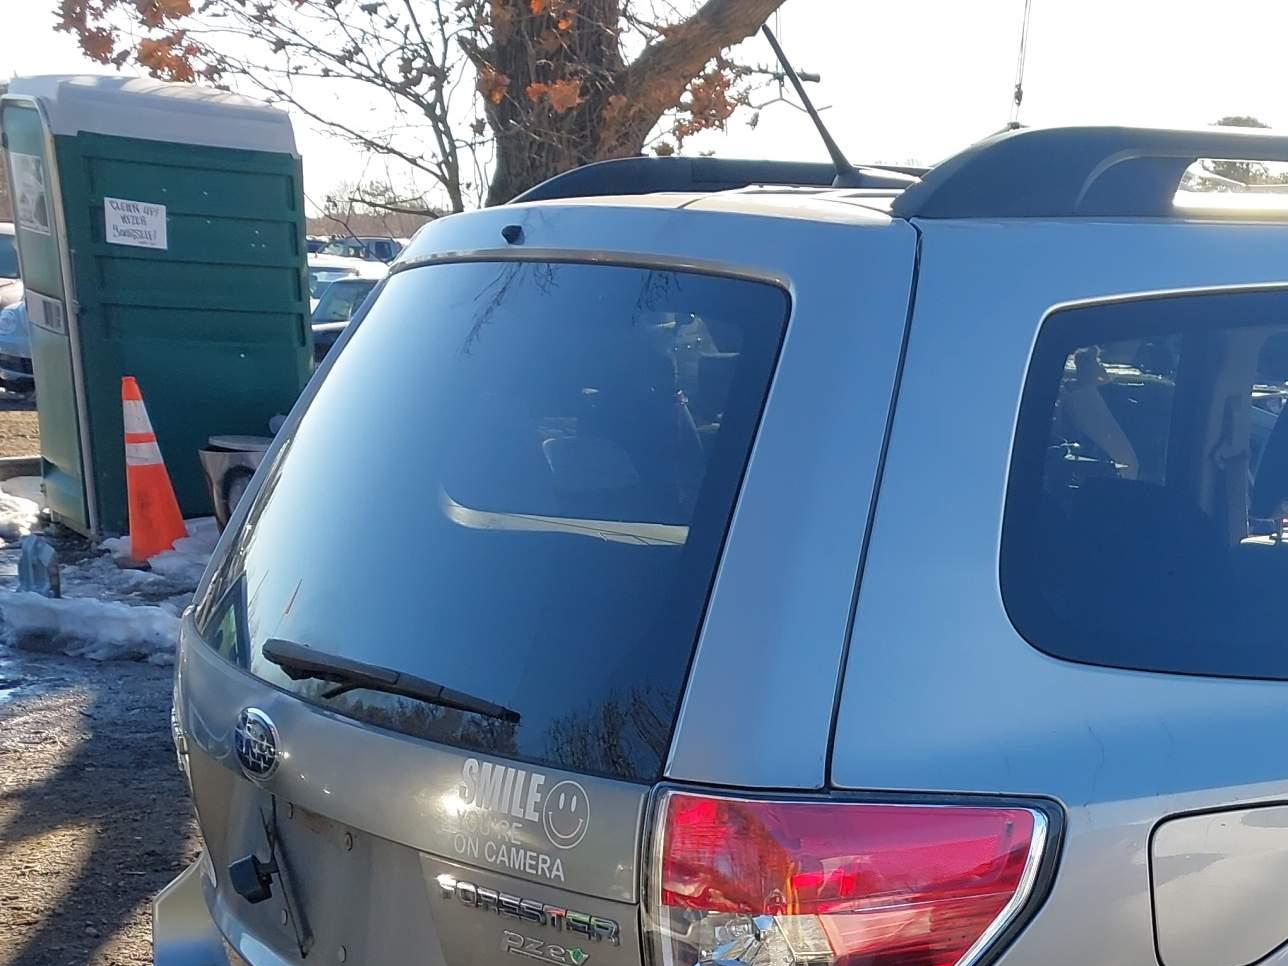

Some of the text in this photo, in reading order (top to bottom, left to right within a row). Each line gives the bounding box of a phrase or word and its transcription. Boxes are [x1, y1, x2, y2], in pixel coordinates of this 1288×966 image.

[458, 757, 546, 823] SMILE
[454, 833, 565, 882] ON CAMERA
[436, 873, 621, 947] FORESTER
